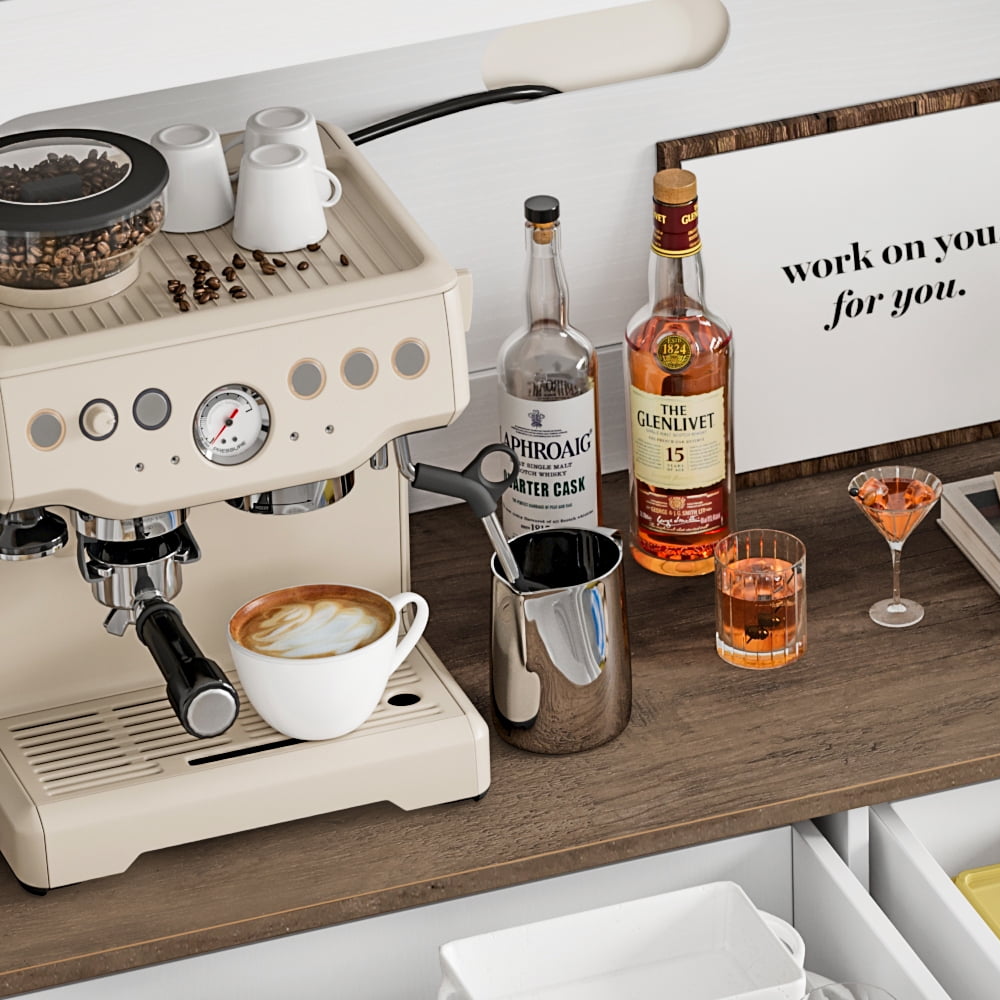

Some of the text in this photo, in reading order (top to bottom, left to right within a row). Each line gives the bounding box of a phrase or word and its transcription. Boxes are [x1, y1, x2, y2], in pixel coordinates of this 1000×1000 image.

[781, 242, 874, 284] work
[882, 239, 927, 265] on
[824, 279, 966, 331] for you.
[663, 343, 687, 355] 1824
[660, 403, 687, 416] THE
[637, 410, 715, 431] GLENLIVET
[503, 427, 592, 460] APHROAIG
[666, 447, 685, 462] 15
[553, 462, 573, 470] MALT
[553, 476, 586, 497] CASK
